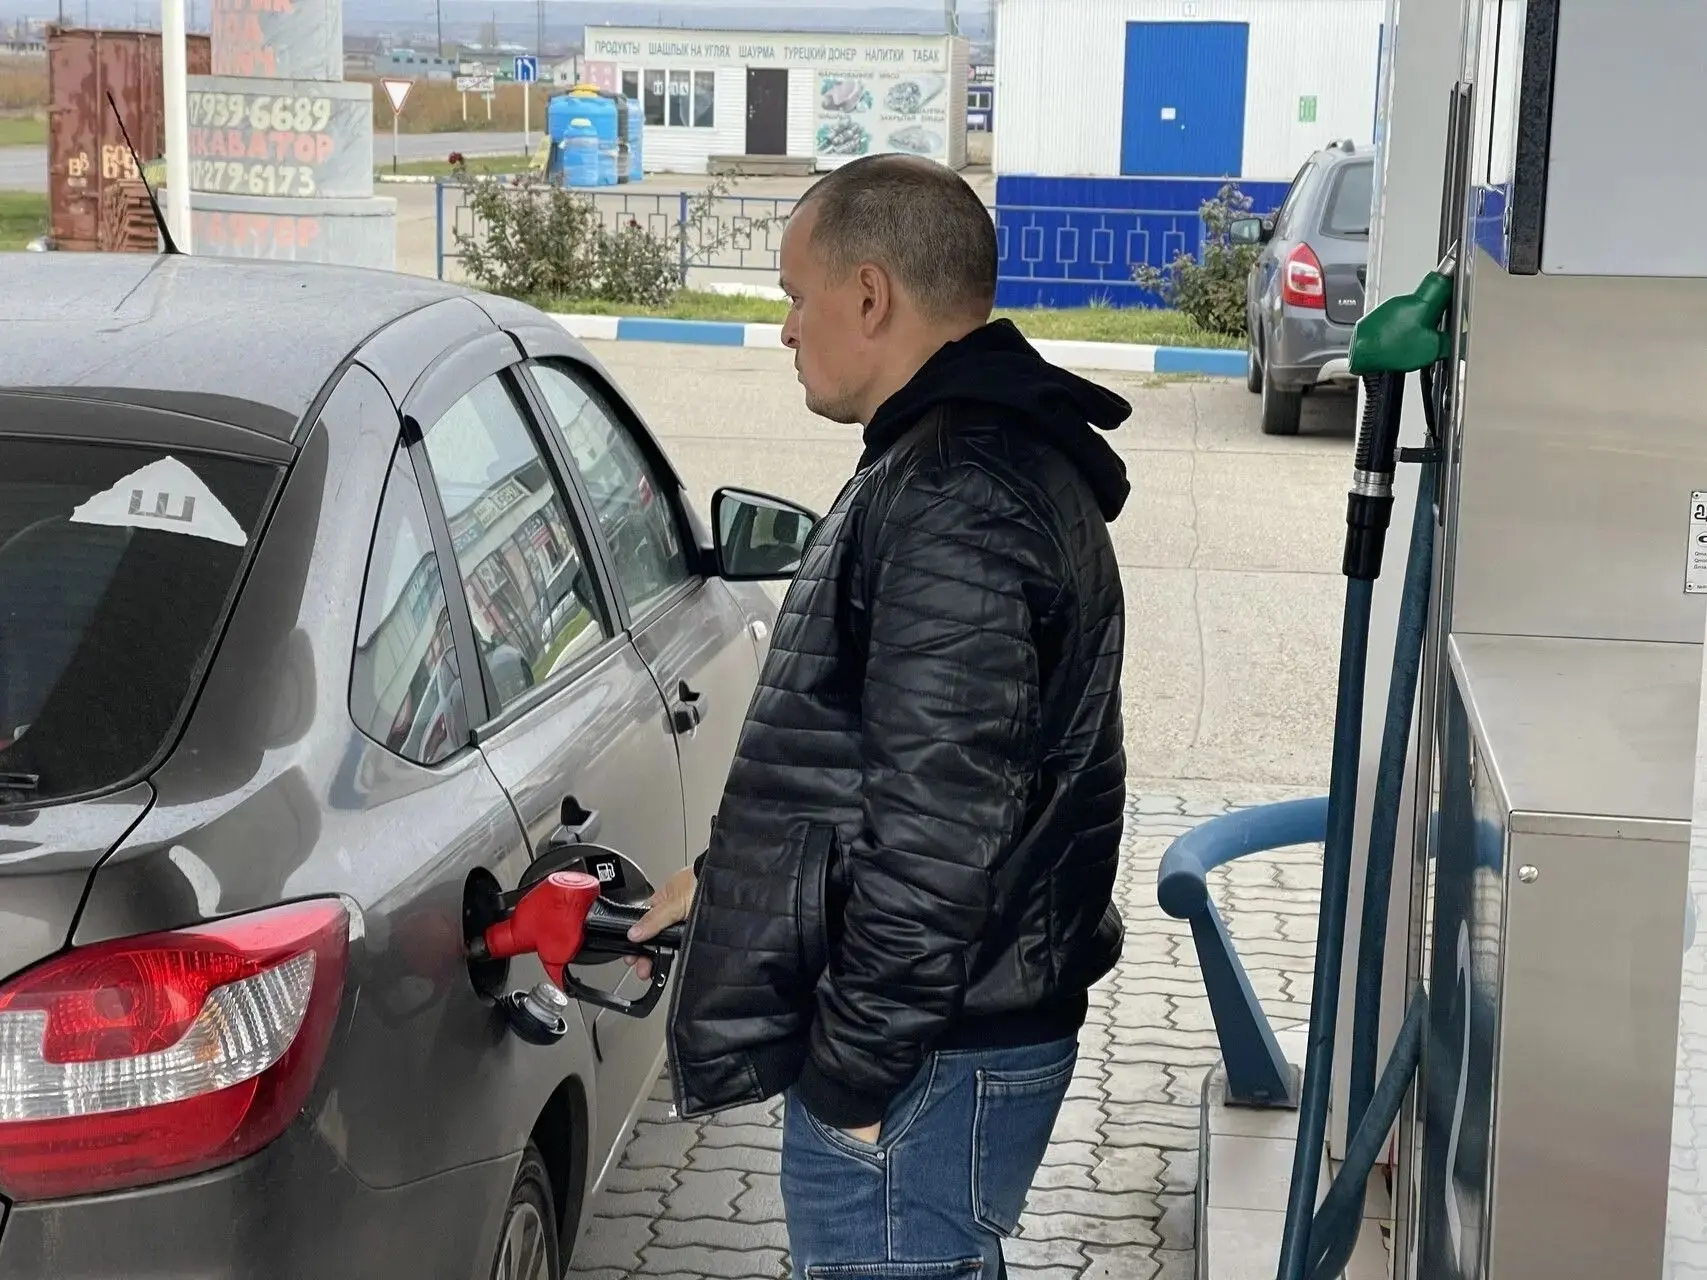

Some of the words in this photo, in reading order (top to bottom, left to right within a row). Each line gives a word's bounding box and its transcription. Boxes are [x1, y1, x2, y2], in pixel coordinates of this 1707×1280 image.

[595, 40, 640, 55] ПРОДУКТЫ
[648, 41, 689, 56] ШАШЛЫК
[690, 43, 702, 56] НА
[704, 44, 730, 57] УГЛЯХ
[738, 45, 775, 58] ШАУРМА
[784, 44, 827, 60] ТУРЕЦКИЙ
[828, 46, 857, 61] ДОНЕР
[865, 47, 904, 61] НАПИТКИ
[912, 48, 940, 62] ТАБАК
